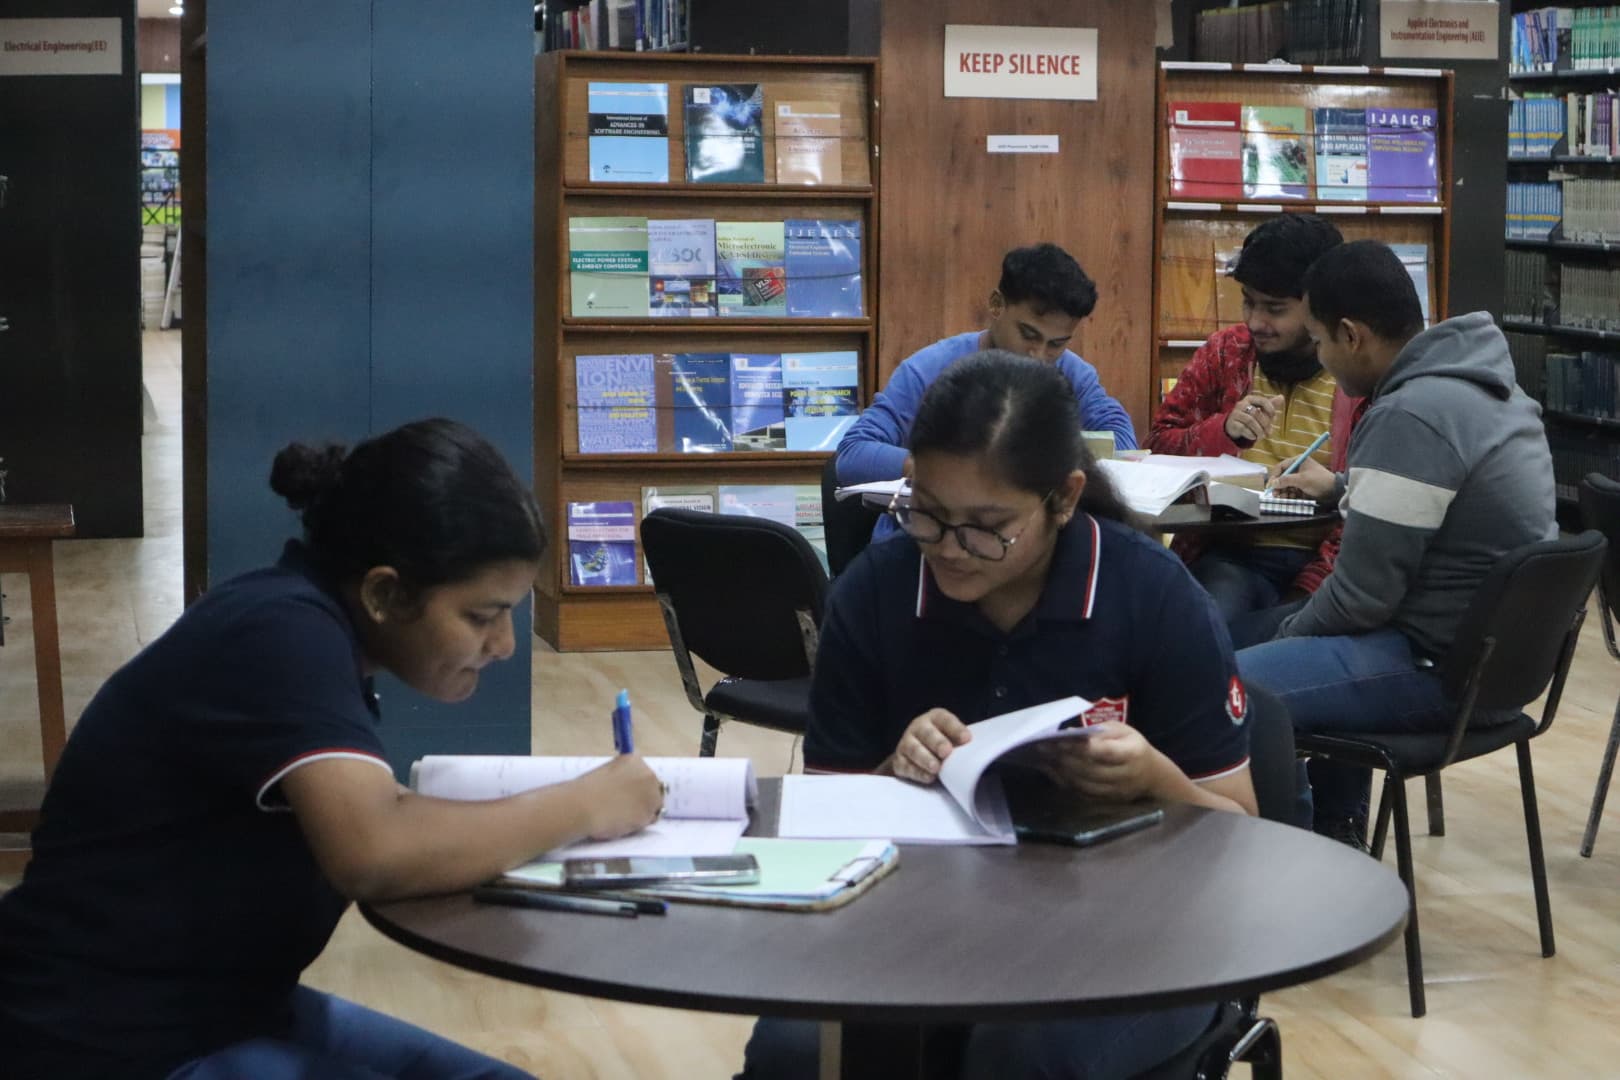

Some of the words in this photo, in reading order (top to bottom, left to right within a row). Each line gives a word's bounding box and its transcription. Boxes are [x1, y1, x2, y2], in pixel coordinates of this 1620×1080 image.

[1407, 17, 1428, 30] Applied
[1429, 17, 1457, 28] Electronics
[1459, 17, 1469, 28] and
[1391, 31, 1435, 41] Instrumentation
[1436, 31, 1468, 43] Engineering
[4, 40, 41, 52] Electrical
[959, 52, 1004, 73] KEEP
[1008, 54, 1081, 75] SILENCE
